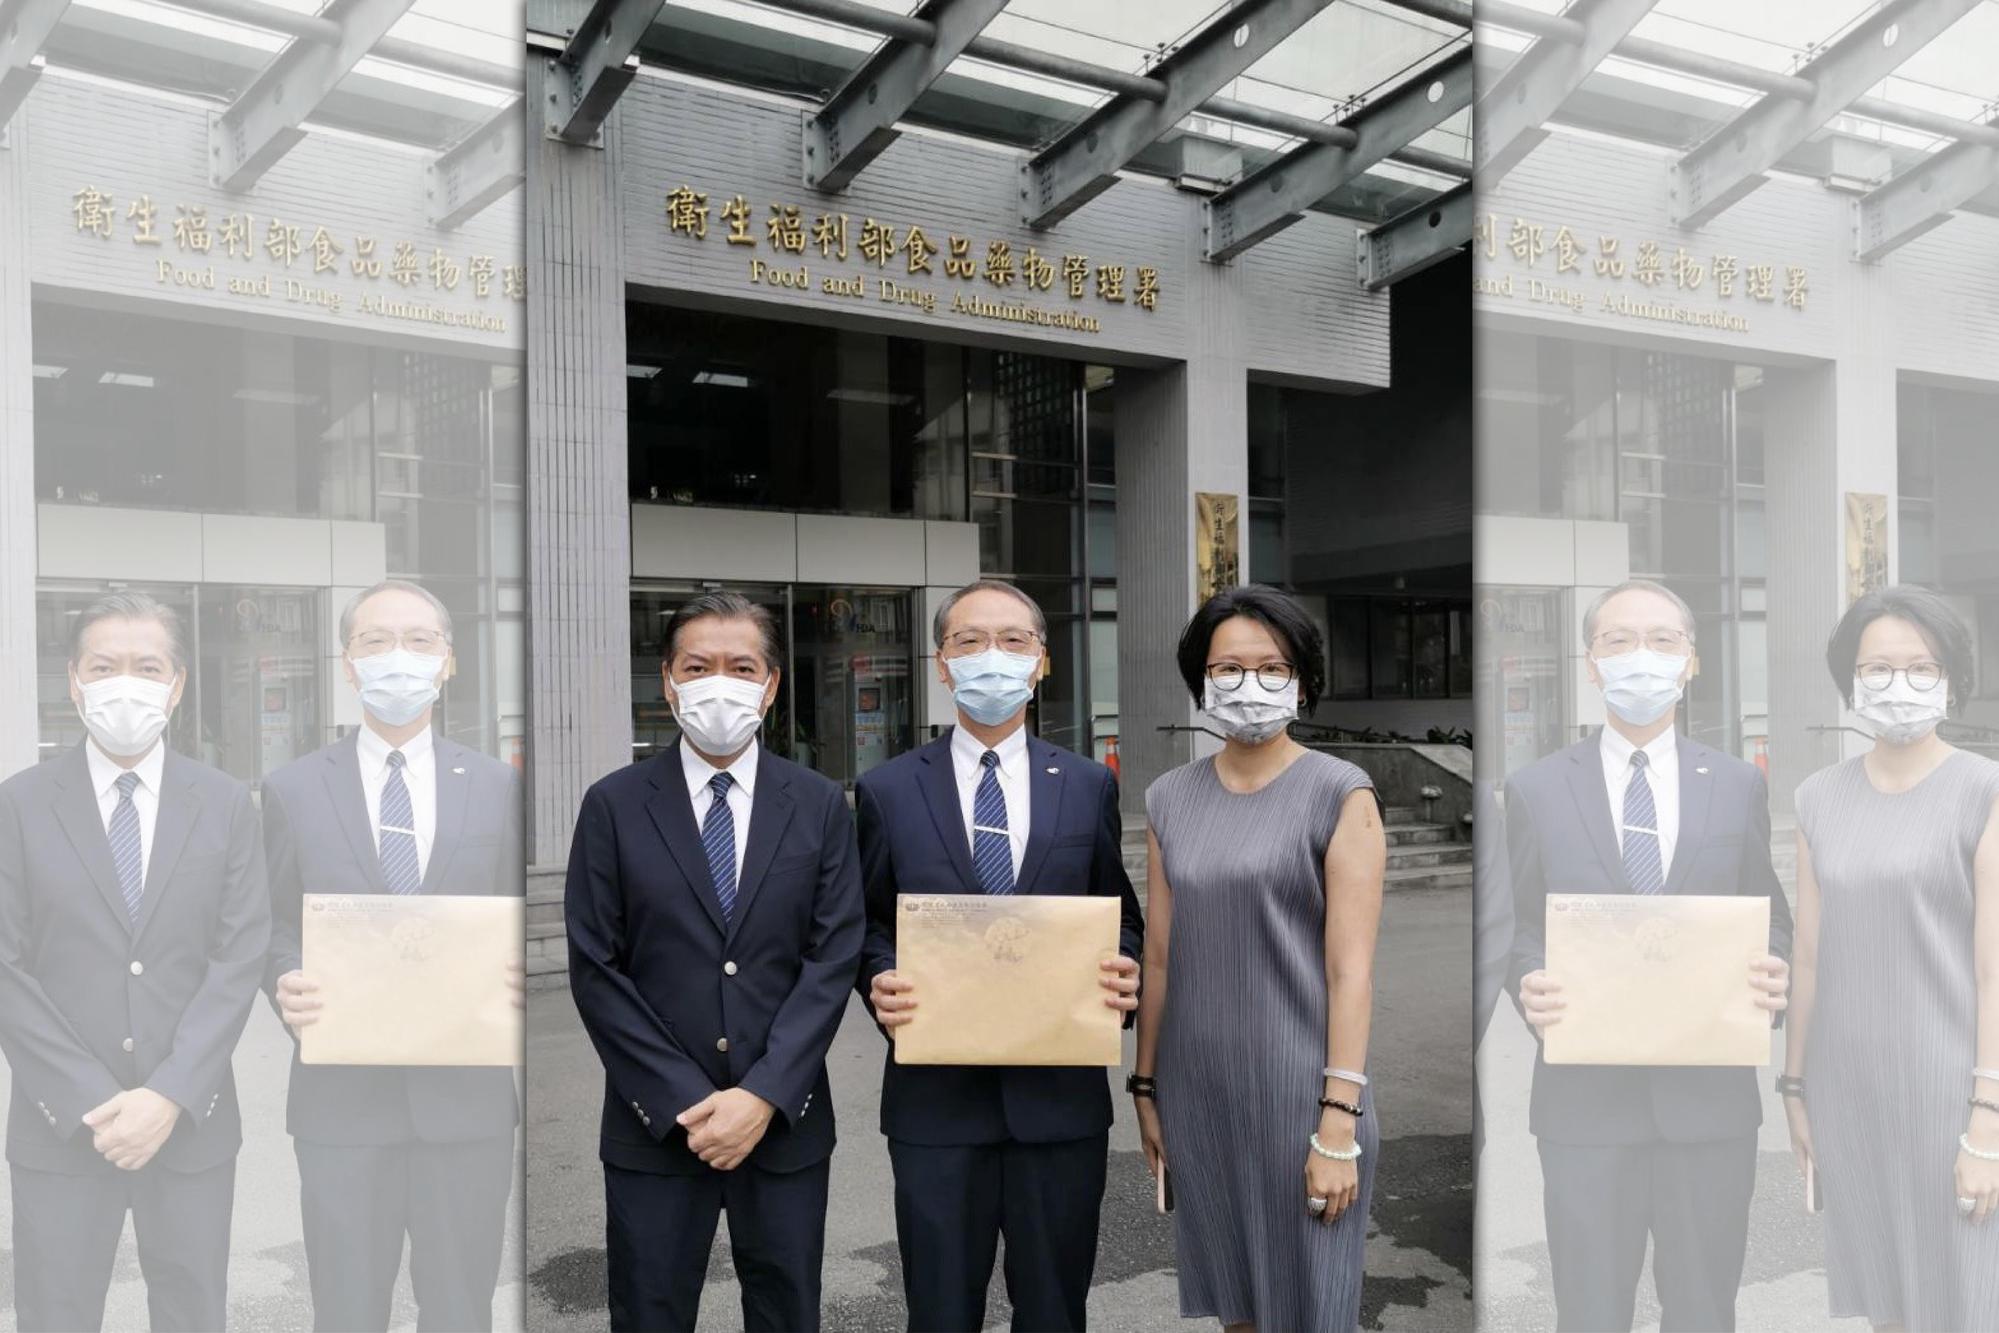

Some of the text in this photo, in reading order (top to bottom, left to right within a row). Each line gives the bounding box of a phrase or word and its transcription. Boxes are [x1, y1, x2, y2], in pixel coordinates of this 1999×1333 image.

[666, 184, 1161, 313] 衛生福利部食品藥物管理署
[157, 258, 507, 333] Food and Drug Administration
[750, 258, 1100, 333] Food and Drug Administration
[1474, 275, 1750, 333] and Drug Administration
